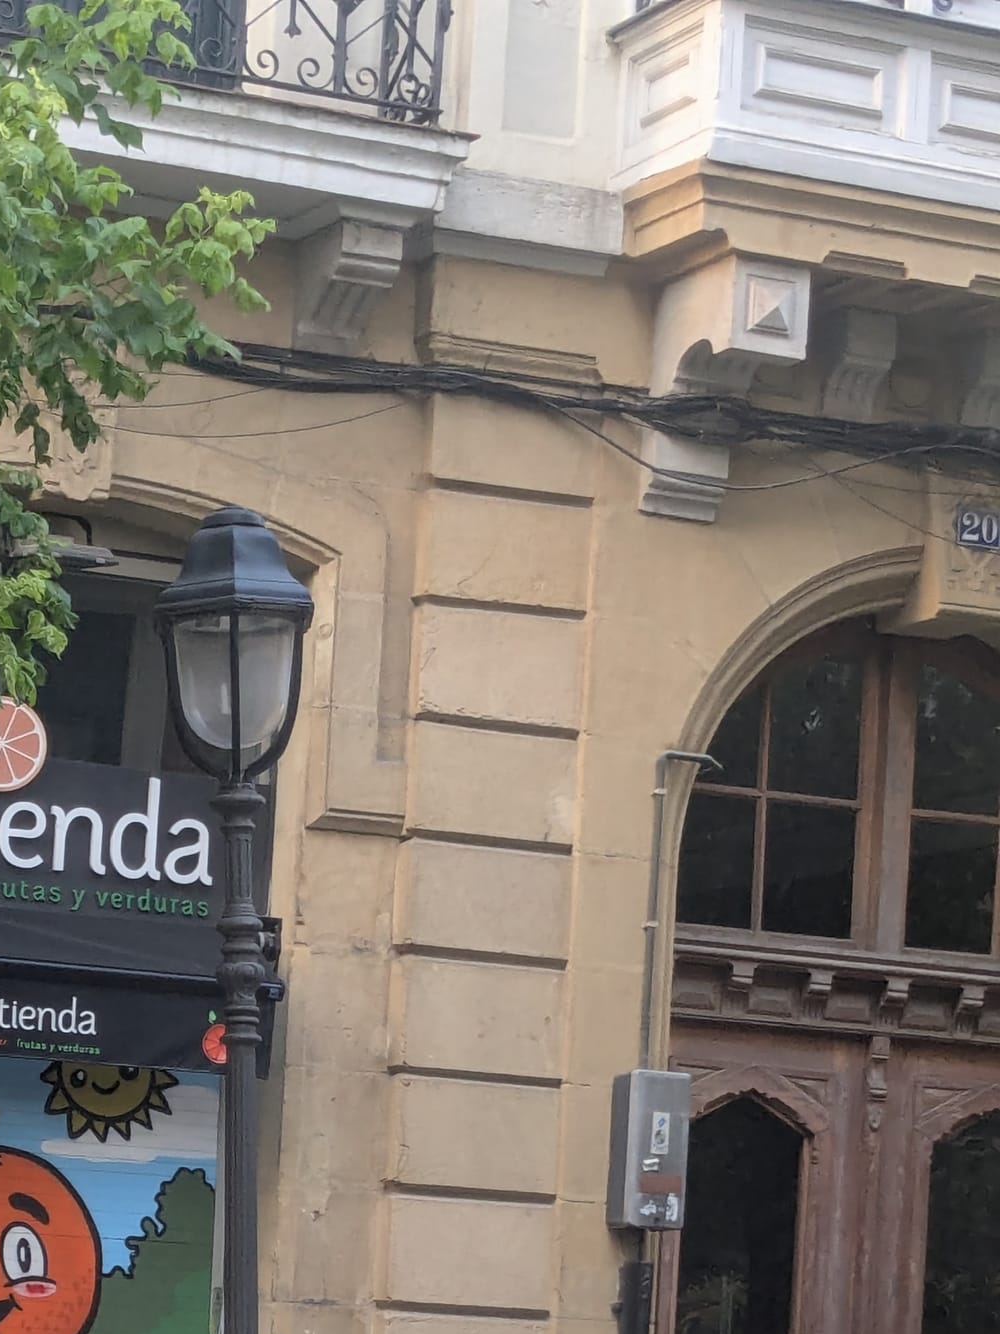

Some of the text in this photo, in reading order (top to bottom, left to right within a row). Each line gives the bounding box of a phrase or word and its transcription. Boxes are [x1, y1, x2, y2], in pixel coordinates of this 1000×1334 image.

[961, 512, 998, 543] 20
[70, 889, 85, 911] y
[96, 888, 209, 917] verduras
[16, 1038, 47, 1050] frutas
[58, 1044, 101, 1055] verduras
